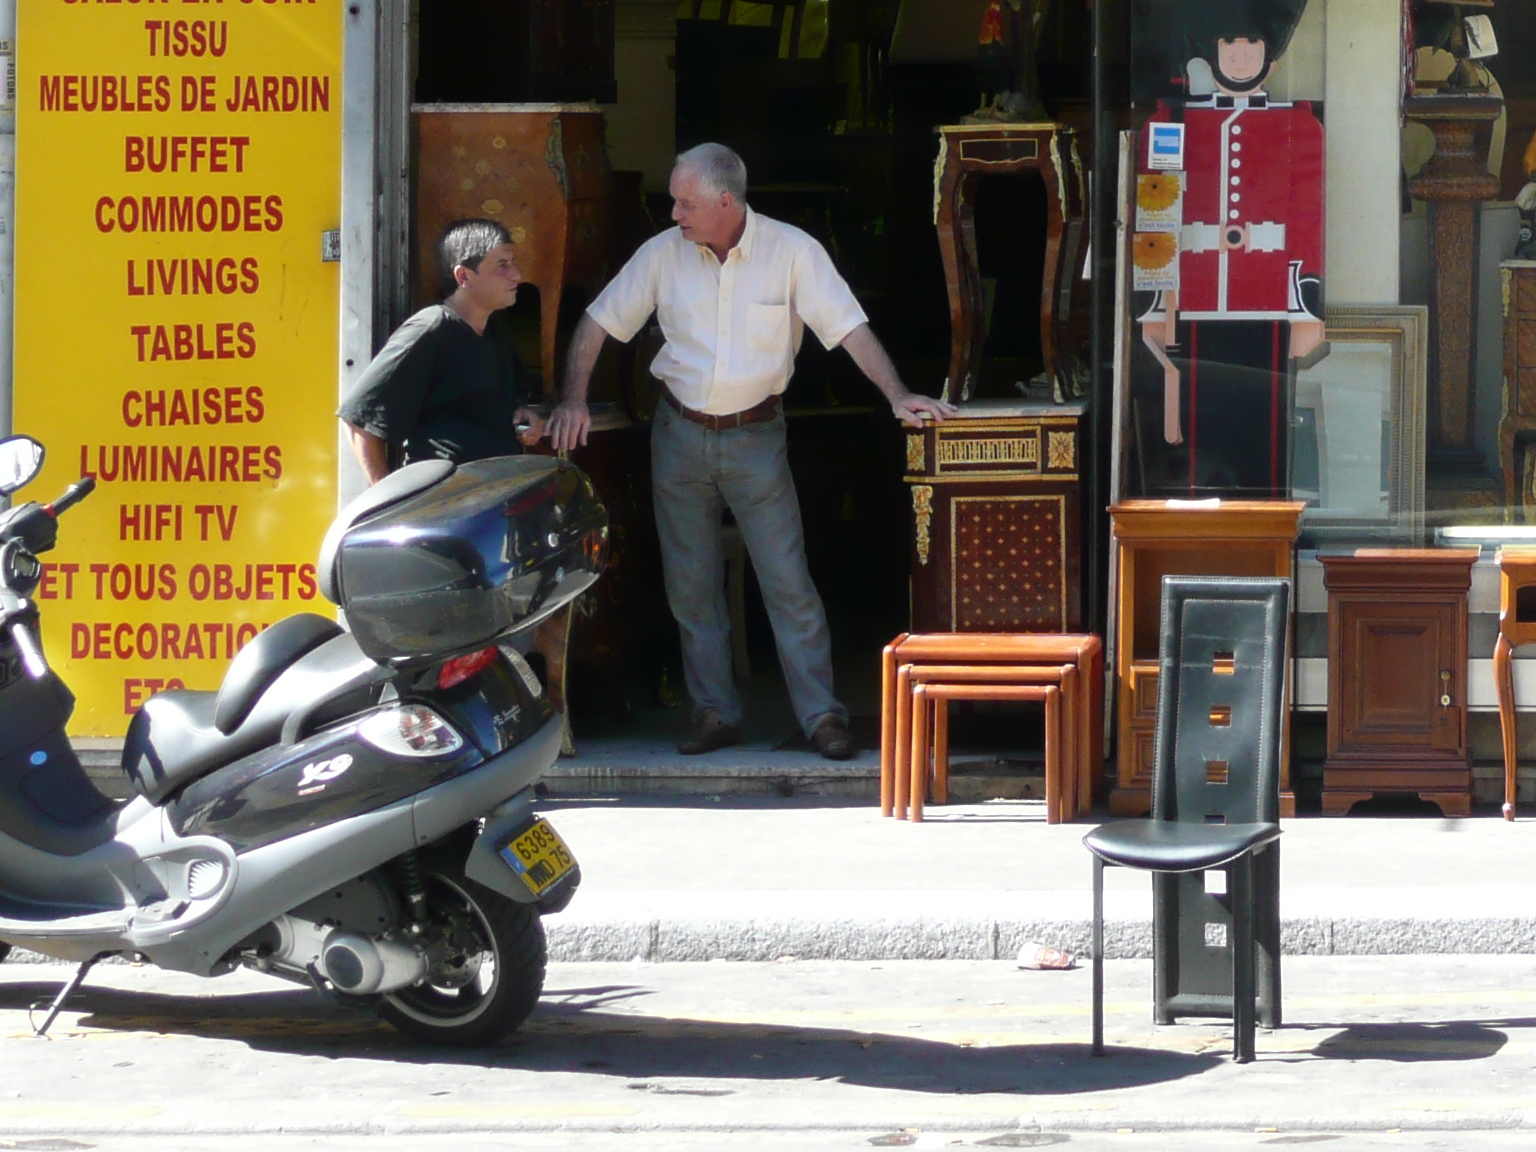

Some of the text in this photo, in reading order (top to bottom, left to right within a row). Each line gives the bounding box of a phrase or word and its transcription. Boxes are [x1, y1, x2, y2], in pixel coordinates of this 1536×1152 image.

[145, 20, 228, 58] TISSU
[39, 75, 329, 113] MEUBLES DE JARDIN
[125, 136, 251, 174] BUFFET
[95, 194, 284, 234] COMMODES
[127, 256, 259, 297] LIVINGS
[131, 321, 257, 362] TABLES
[122, 385, 265, 428] CHAISES
[80, 445, 282, 483] LUMINAIRES
[120, 504, 239, 541] HIFI TV
[40, 562, 318, 601] ET TOUS OBJETS
[71, 622, 268, 660] DECORATIO
[124, 678, 185, 715] ET
[298, 754, 353, 786] X9
[516, 824, 554, 860] 6389
[549, 845, 571, 870] 75
